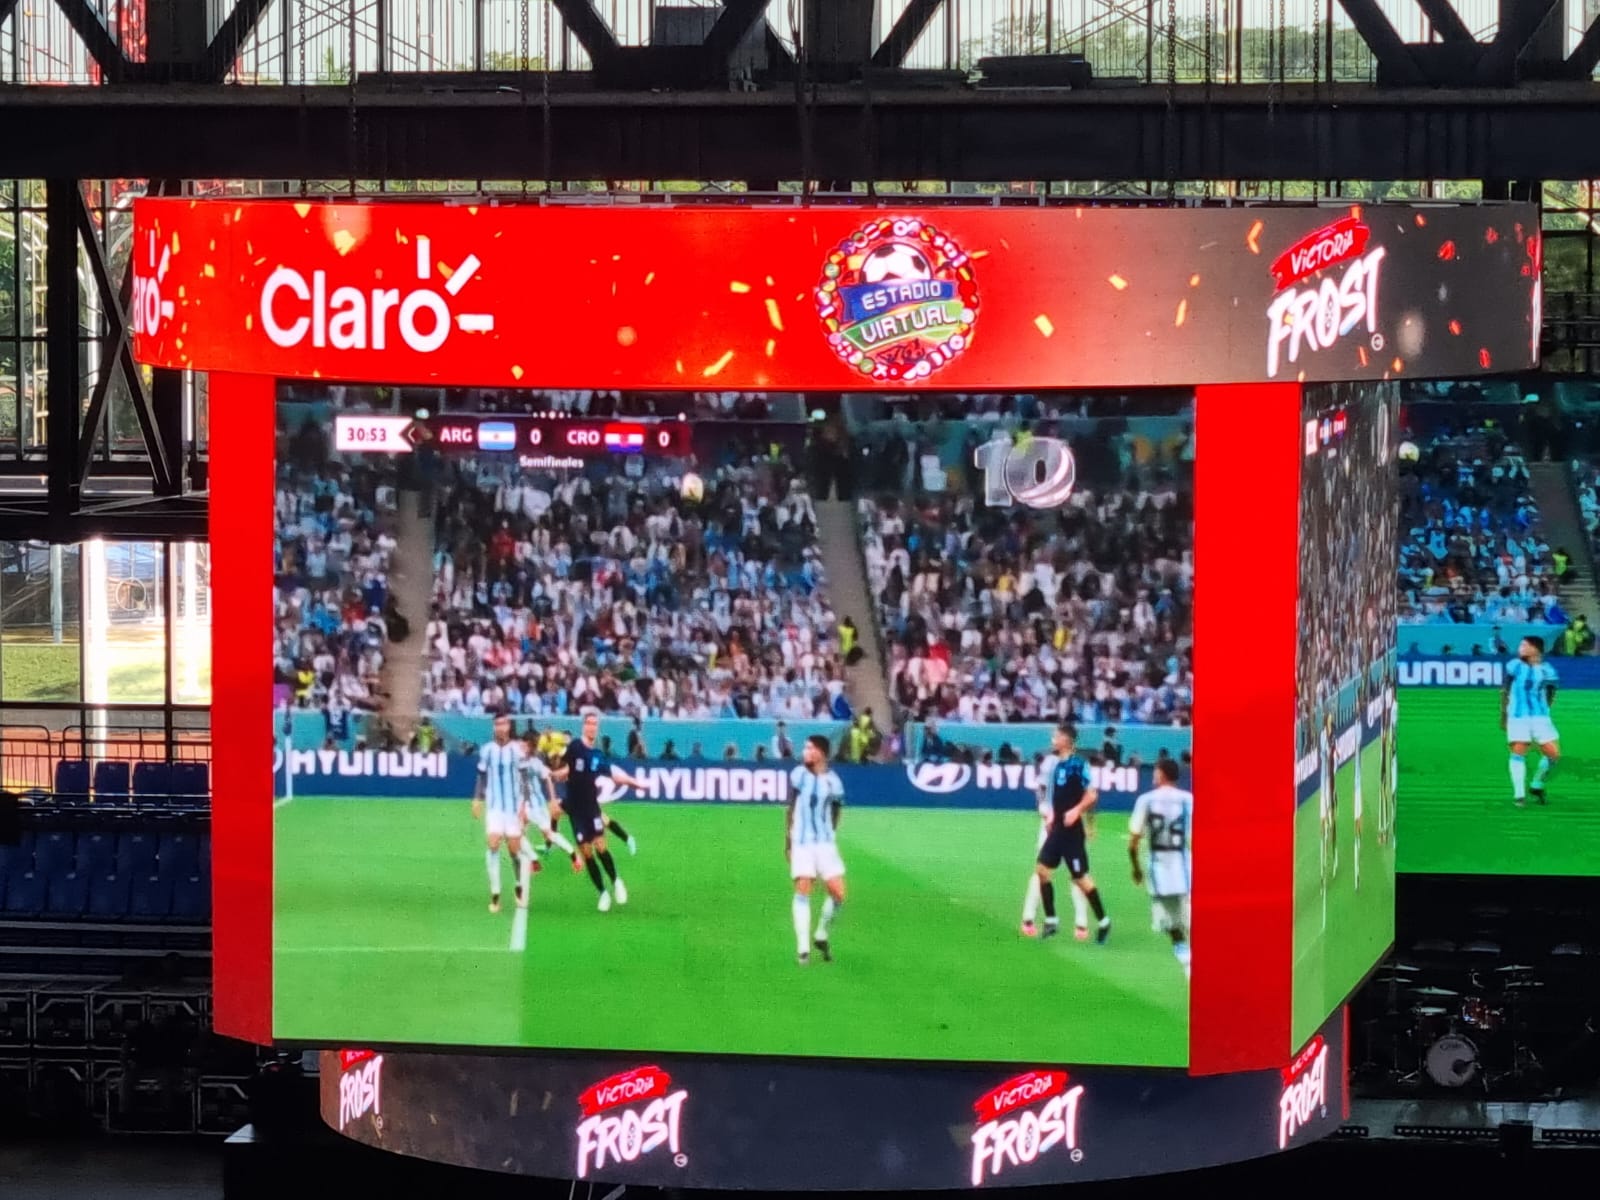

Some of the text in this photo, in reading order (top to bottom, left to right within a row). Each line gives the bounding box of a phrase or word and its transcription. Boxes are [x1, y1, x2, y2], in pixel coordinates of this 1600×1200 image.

[133, 275, 160, 337] aro
[260, 267, 451, 352] Claro
[859, 305, 958, 343] VIRTUAL
[861, 281, 942, 311] ESTADIO
[1266, 245, 1386, 378] FROST
[346, 427, 387, 442] 30:53
[439, 428, 670, 447] ARG 0 CRO 0
[519, 455, 585, 468] Semifinales
[974, 436, 1076, 508] 10
[1397, 660, 1503, 685] UNDAI
[635, 765, 788, 800] HYUNDAI
[340, 1055, 383, 1131] FROST
[1280, 1044, 1327, 1149] FROST
[576, 1089, 688, 1178] FROST
[971, 1085, 1084, 1186] FROST
